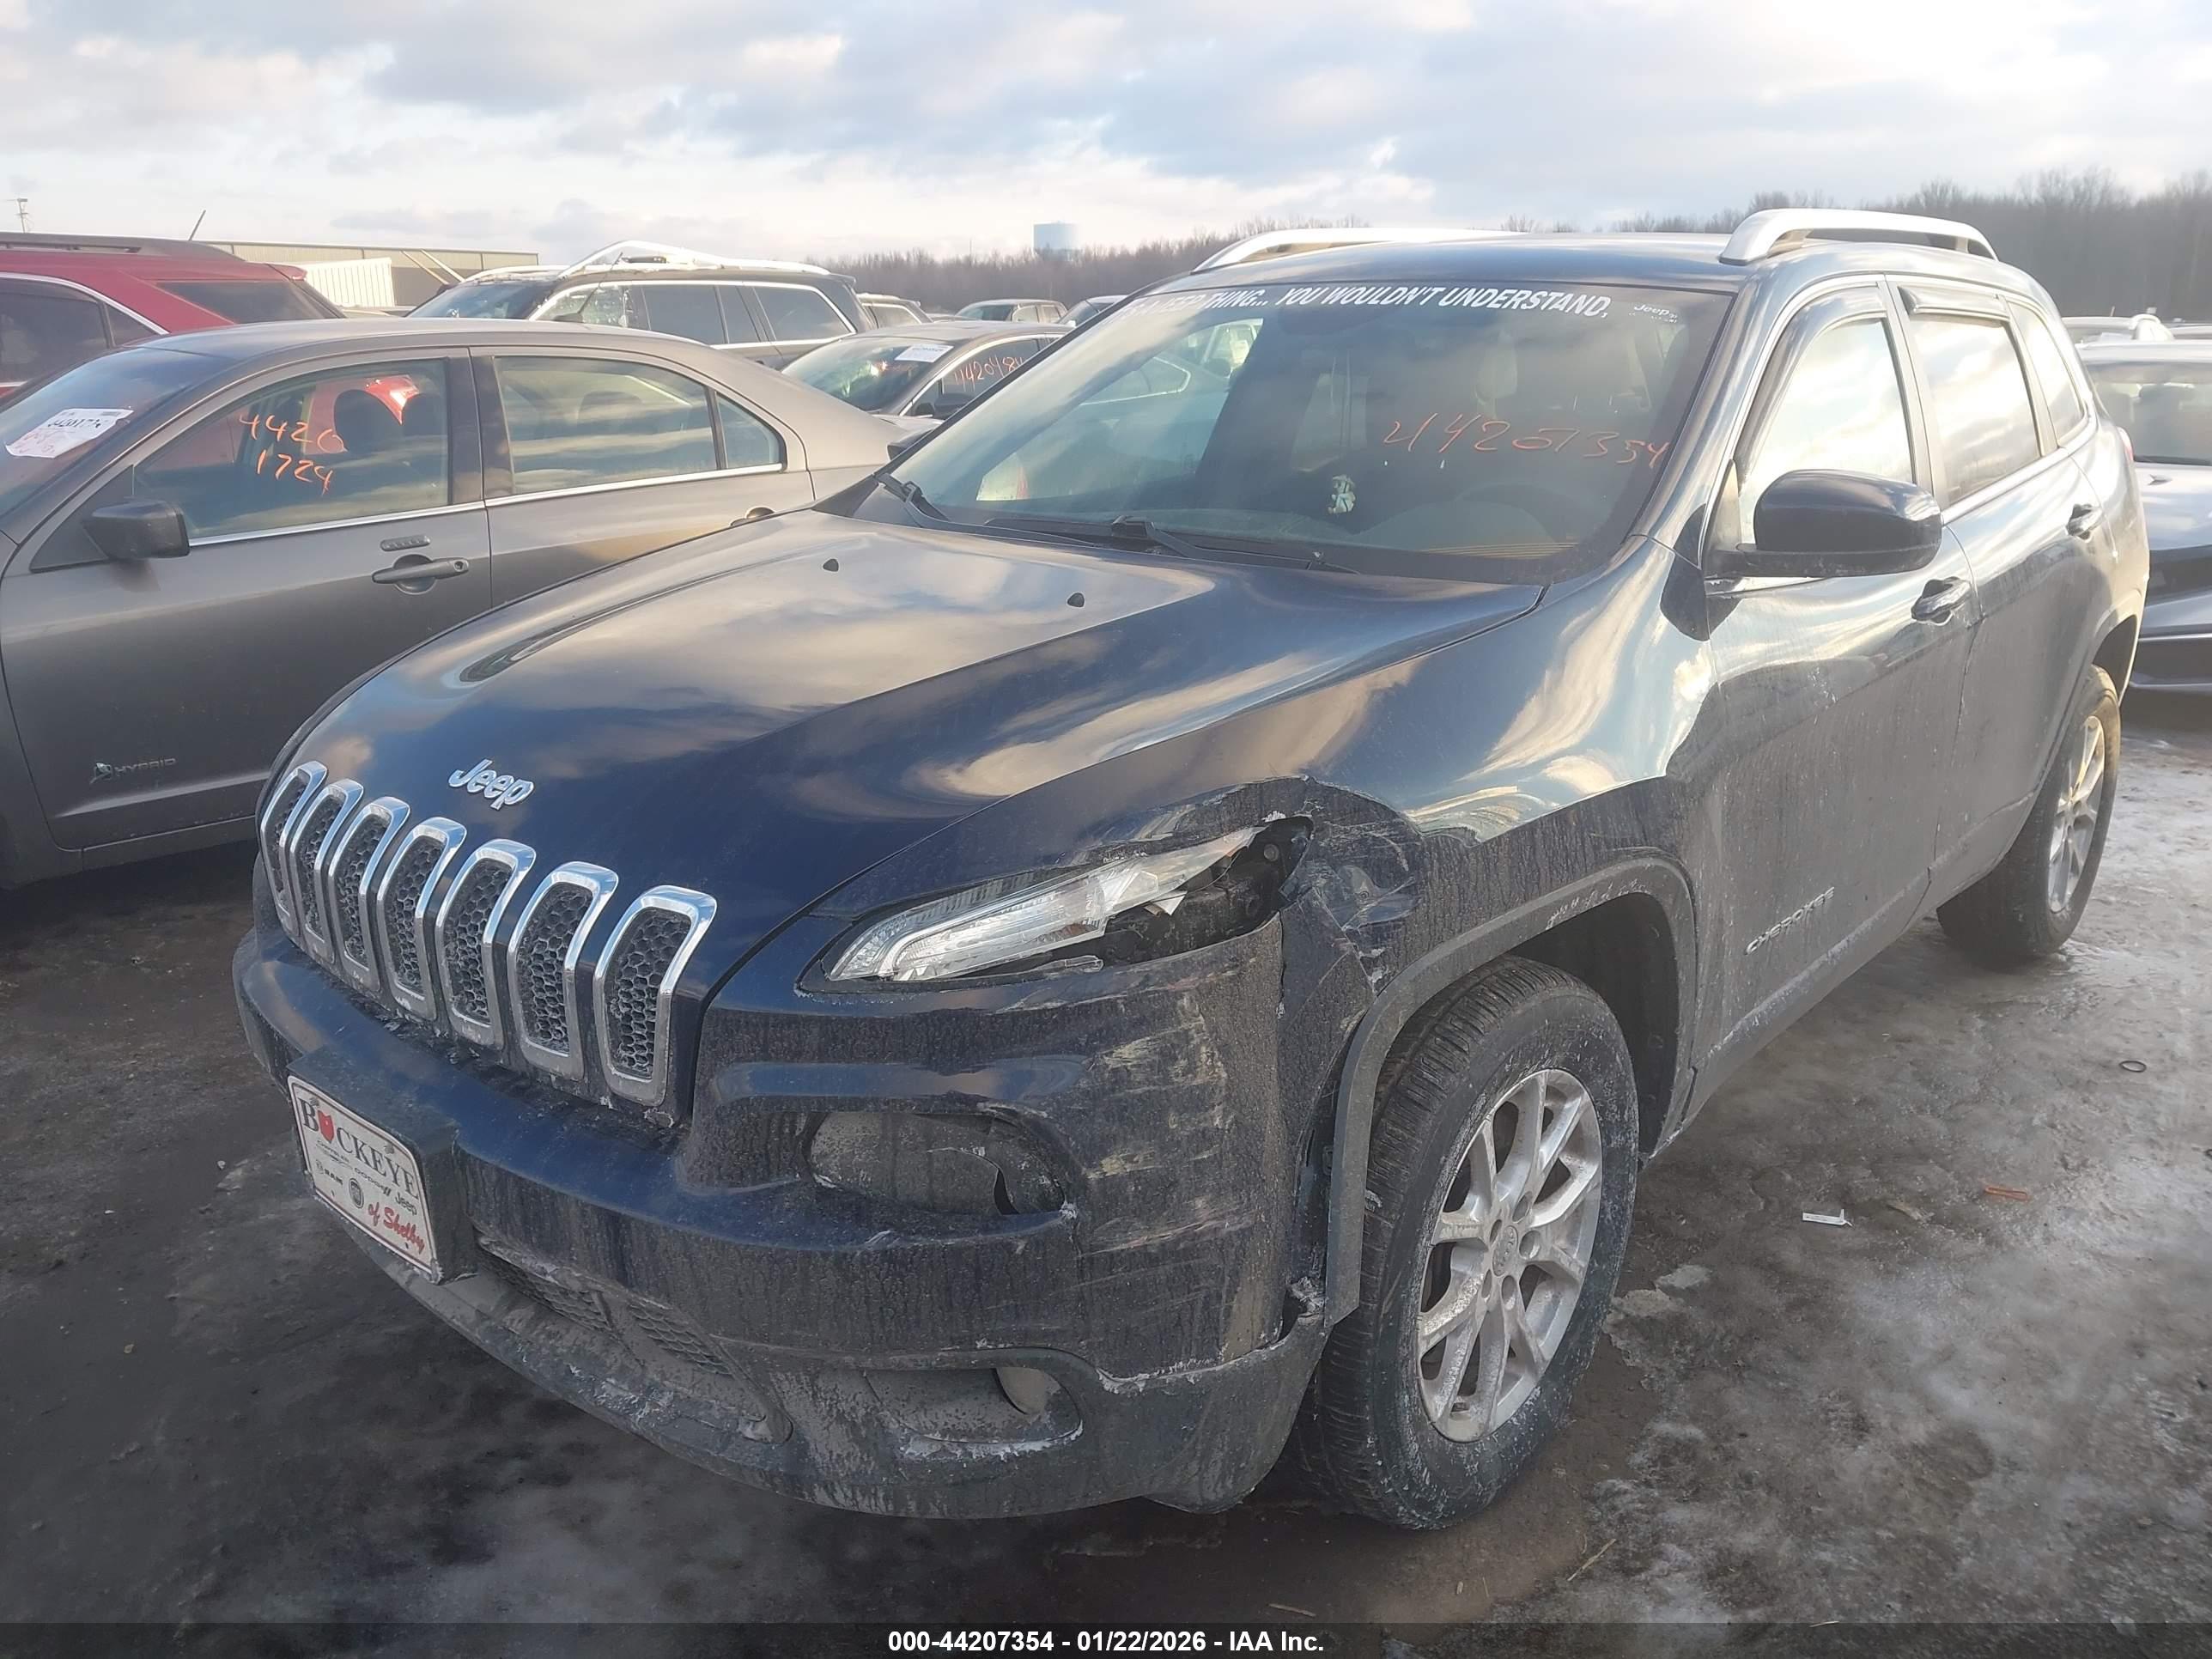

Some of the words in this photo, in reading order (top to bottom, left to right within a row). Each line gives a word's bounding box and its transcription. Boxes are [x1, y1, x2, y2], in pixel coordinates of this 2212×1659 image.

[1275, 288, 1330, 306] YOU
[1321, 286, 1446, 307] WOULDN'T
[239, 414, 348, 453] 4420
[257, 449, 333, 495] 1724
[447, 758, 534, 811] Jeep
[395, 1191, 417, 1216] Jeep
[367, 1201, 380, 1227] of
[383, 1206, 425, 1255] Shelby
